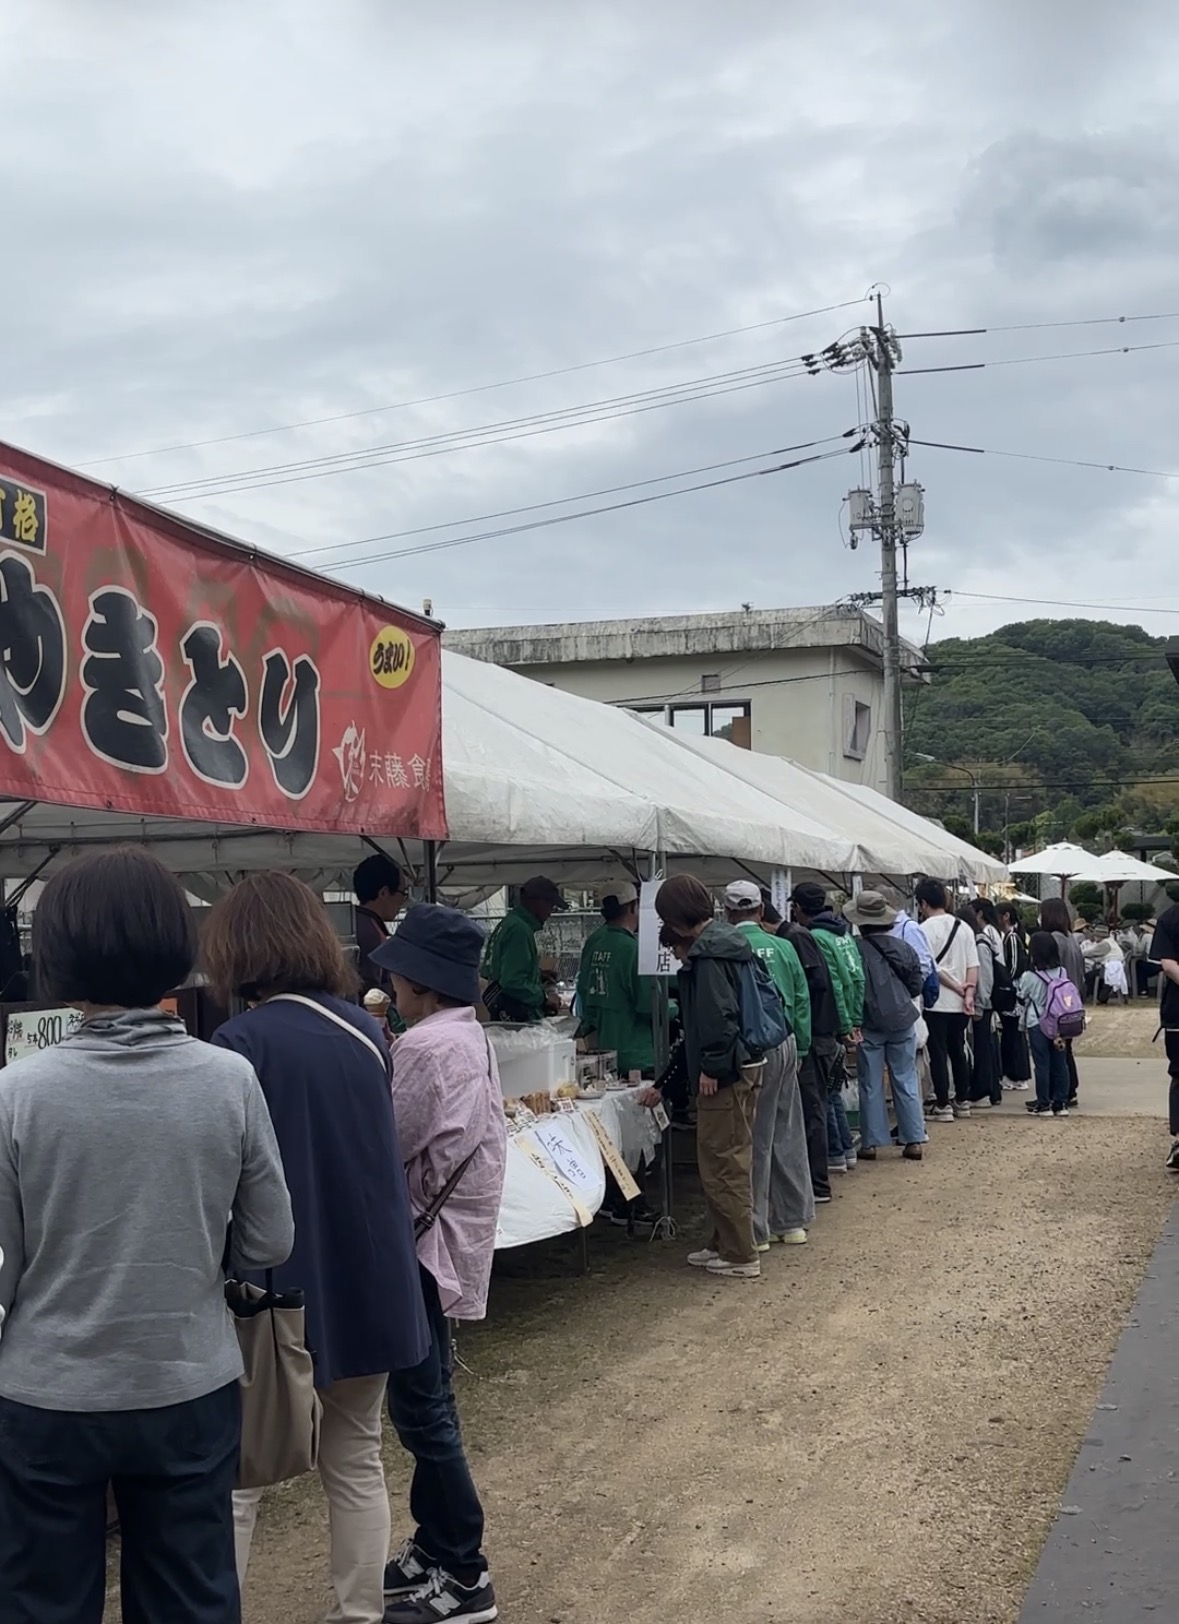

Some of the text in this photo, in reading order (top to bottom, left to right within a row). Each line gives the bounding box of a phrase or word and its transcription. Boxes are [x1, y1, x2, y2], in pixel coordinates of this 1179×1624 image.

[0, 487, 39, 542] 格
[0, 549, 321, 801] やきとり
[369, 749, 431, 792] 末藤食
